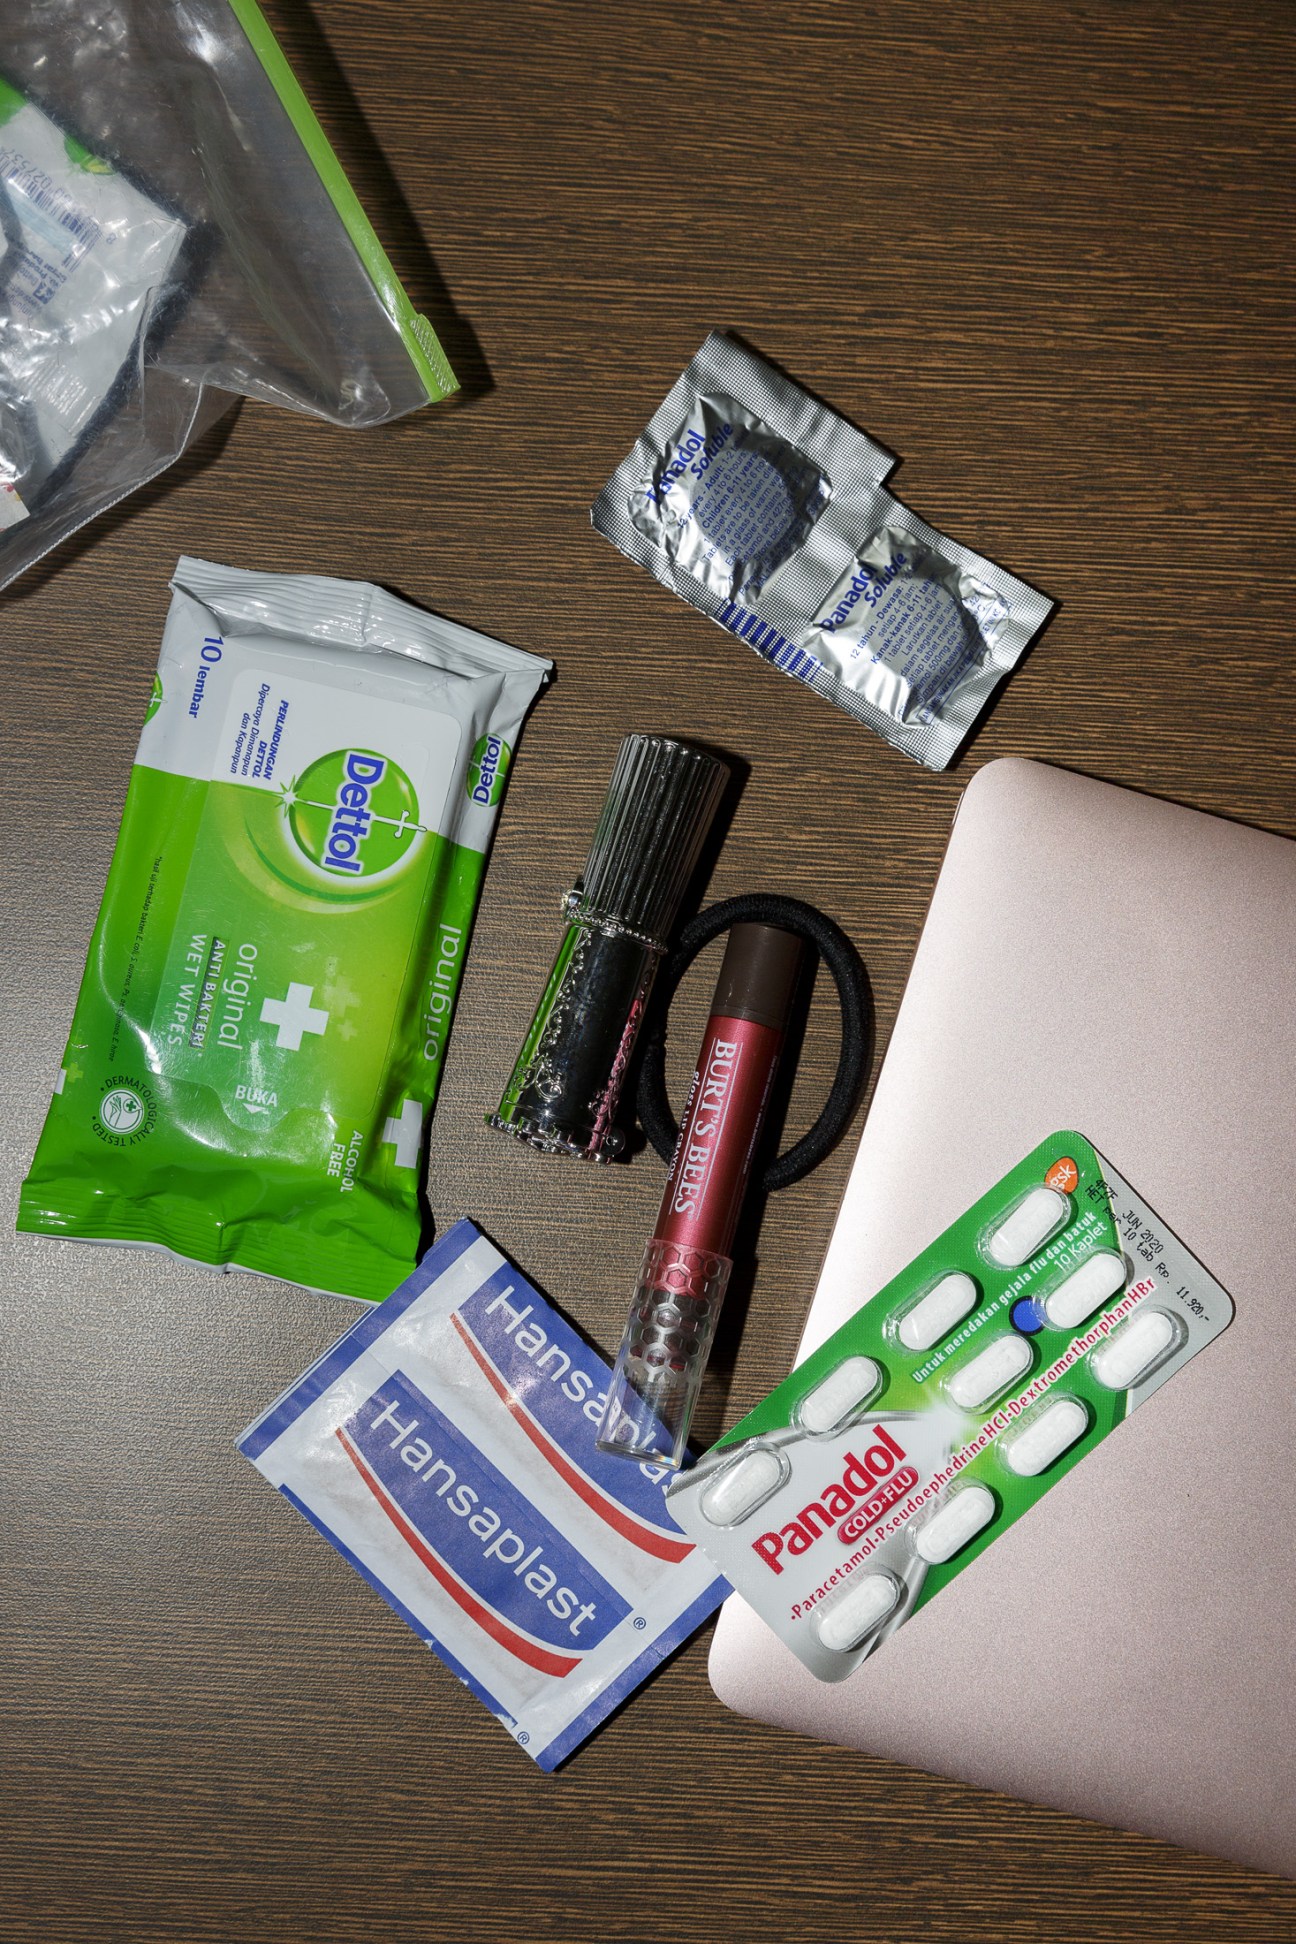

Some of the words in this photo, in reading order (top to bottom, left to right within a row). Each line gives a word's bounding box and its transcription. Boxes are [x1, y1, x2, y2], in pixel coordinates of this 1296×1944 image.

[697, 494, 718, 519] every
[712, 488, 721, 496] 4
[717, 479, 727, 490] to
[722, 472, 731, 481] 6
[701, 492, 730, 529] Children
[725, 474, 742, 494] 6-11
[703, 463, 725, 490] Adult:
[707, 513, 727, 539] tablet
[723, 492, 743, 516] every
[738, 486, 746, 494] 4
[742, 476, 753, 488] to
[748, 470, 757, 478] 6
[722, 519, 736, 536] are
[738, 498, 750, 511] be
[745, 476, 765, 501] taken
[724, 544, 743, 566] Each
[738, 522, 759, 547] tablet
[754, 488, 782, 525] contains
[731, 516, 752, 540] glass
[746, 506, 757, 518] of
[753, 486, 772, 509] warm
[760, 517, 774, 535] and
[819, 559, 878, 635] Panadol
[861, 549, 908, 608] Soluble
[849, 647, 860, 659] 12
[856, 623, 877, 650] tahun
[876, 583, 904, 620] Dewasa:
[870, 610, 910, 665] Kanak-kanak
[906, 592, 922, 612] 6-11
[876, 612, 898, 639] setiap
[892, 599, 906, 614] 4-6
[888, 633, 907, 658] tablet
[903, 610, 925, 636] setiap
[919, 596, 933, 612] 4-6
[899, 652, 919, 677] dalam
[915, 623, 940, 655] segelas
[935, 612, 946, 625] air
[901, 620, 928, 656] Larutkan
[923, 599, 943, 623] tablet
[199, 633, 225, 664] 10
[920, 639, 940, 664] tablet
[927, 643, 951, 672] 500mg
[945, 628, 960, 646] dan
[943, 636, 967, 666] bawah
[187, 664, 210, 719] lembar
[250, 682, 270, 726] Dipercaya
[239, 712, 251, 729] dan
[262, 698, 289, 780] PERLINDUNGAN
[228, 729, 247, 774] Kapanpun
[240, 726, 259, 776] Dimanapun
[251, 740, 267, 778] DETTOL
[471, 735, 504, 804] Dettol
[323, 753, 384, 872] Dettol
[183, 932, 207, 977] WET
[207, 939, 226, 979] ANTI
[166, 981, 195, 1046] WIPES
[212, 940, 262, 1050] original
[409, 922, 469, 1062] original
[104, 1075, 156, 1145] DERMATOLOGICALLY
[235, 1084, 277, 1106] BUKA
[695, 1038, 737, 1138] BURT'S
[92, 1123, 125, 1146] TESTED
[326, 1142, 345, 1177] FREE
[339, 1129, 363, 1194] ALCOHOL
[675, 1143, 710, 1214] BEES
[1045, 1160, 1080, 1193] gsk
[1052, 1252, 1072, 1271] 10
[1067, 1219, 1109, 1259] Kaplet
[1083, 1183, 1104, 1205] HET
[1121, 1226, 1137, 1242] 10
[1134, 1240, 1156, 1264] tab
[1121, 1208, 1143, 1231] JUN
[1139, 1227, 1165, 1255] 2020
[911, 1350, 946, 1383] Untuk
[940, 1299, 1001, 1356] meredakan
[995, 1269, 1035, 1307] gejala
[1028, 1254, 1048, 1275] flu
[1043, 1238, 1067, 1261] dan
[1062, 1209, 1097, 1242] batuk
[372, 1400, 598, 1637] Hansaplast
[749, 1423, 908, 1576] Panadol
